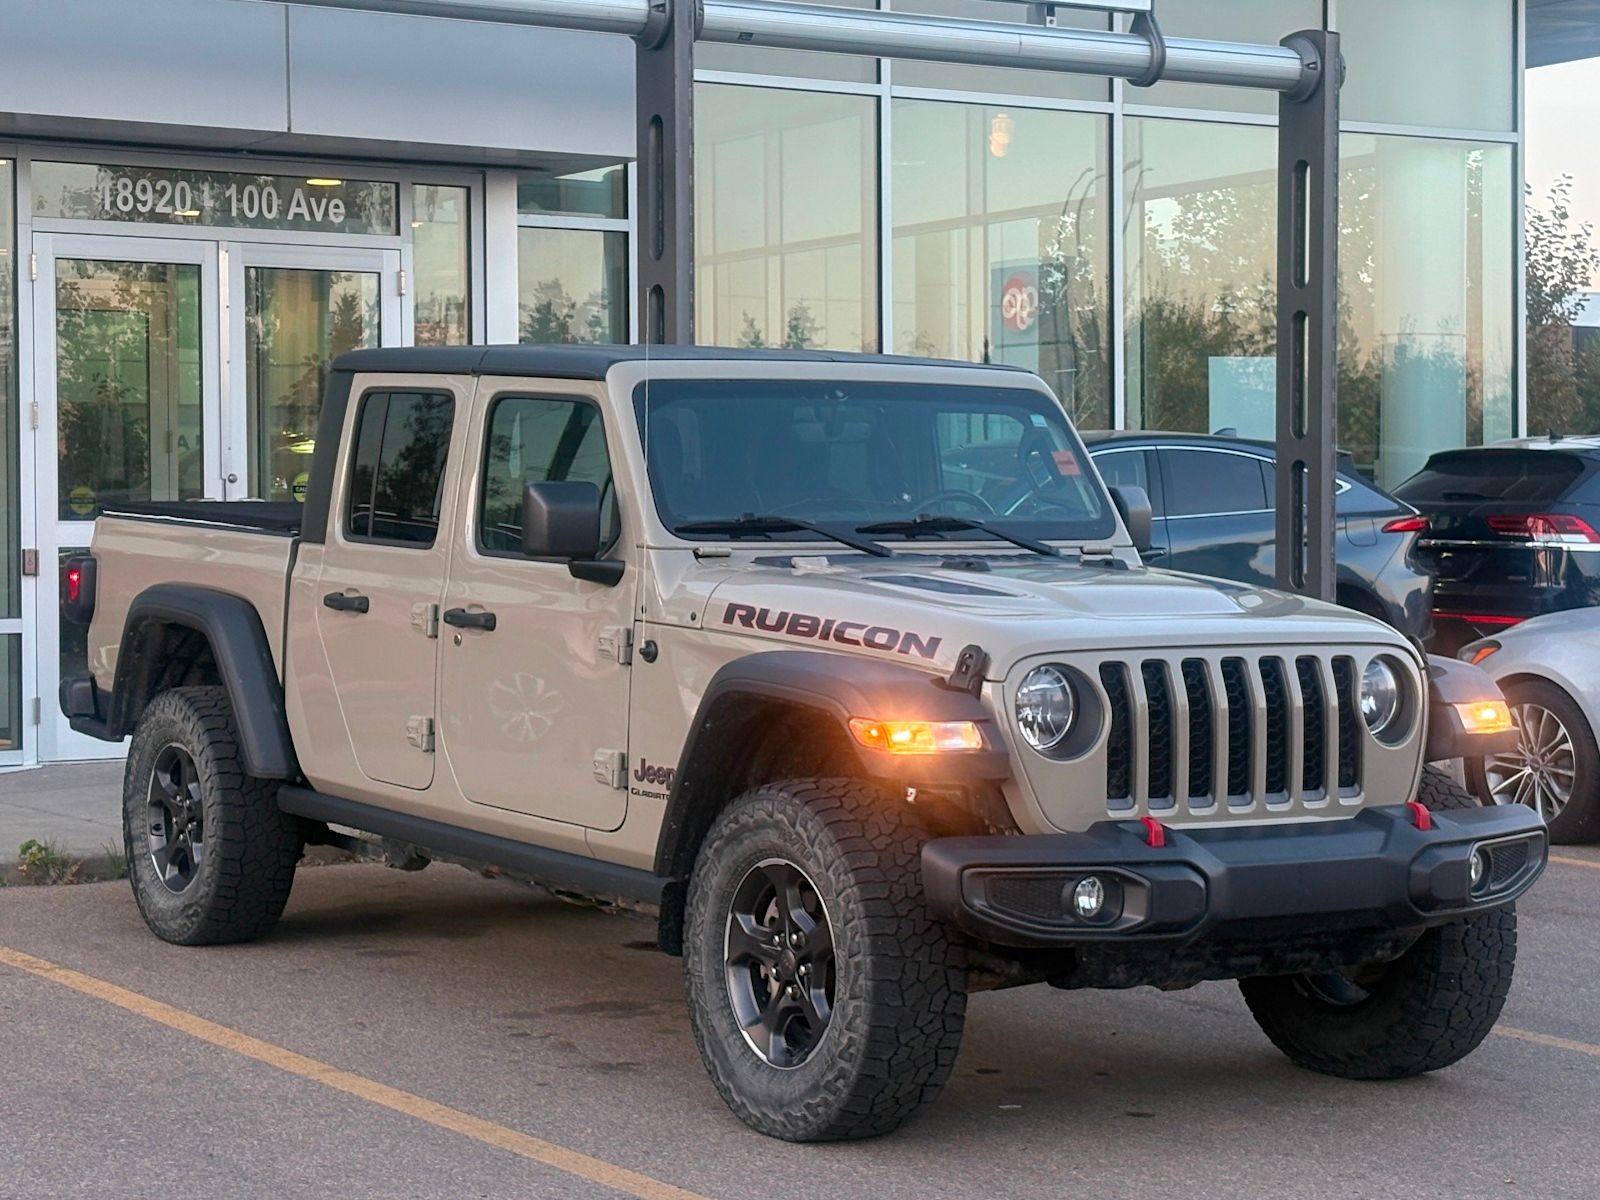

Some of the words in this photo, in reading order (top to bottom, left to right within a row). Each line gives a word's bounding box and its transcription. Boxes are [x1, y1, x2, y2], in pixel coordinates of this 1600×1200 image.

[102, 177, 192, 213] 18920
[224, 183, 277, 219] 100
[287, 188, 346, 222] Ave
[722, 602, 943, 659] RUBICON
[634, 758, 677, 791] Jeep
